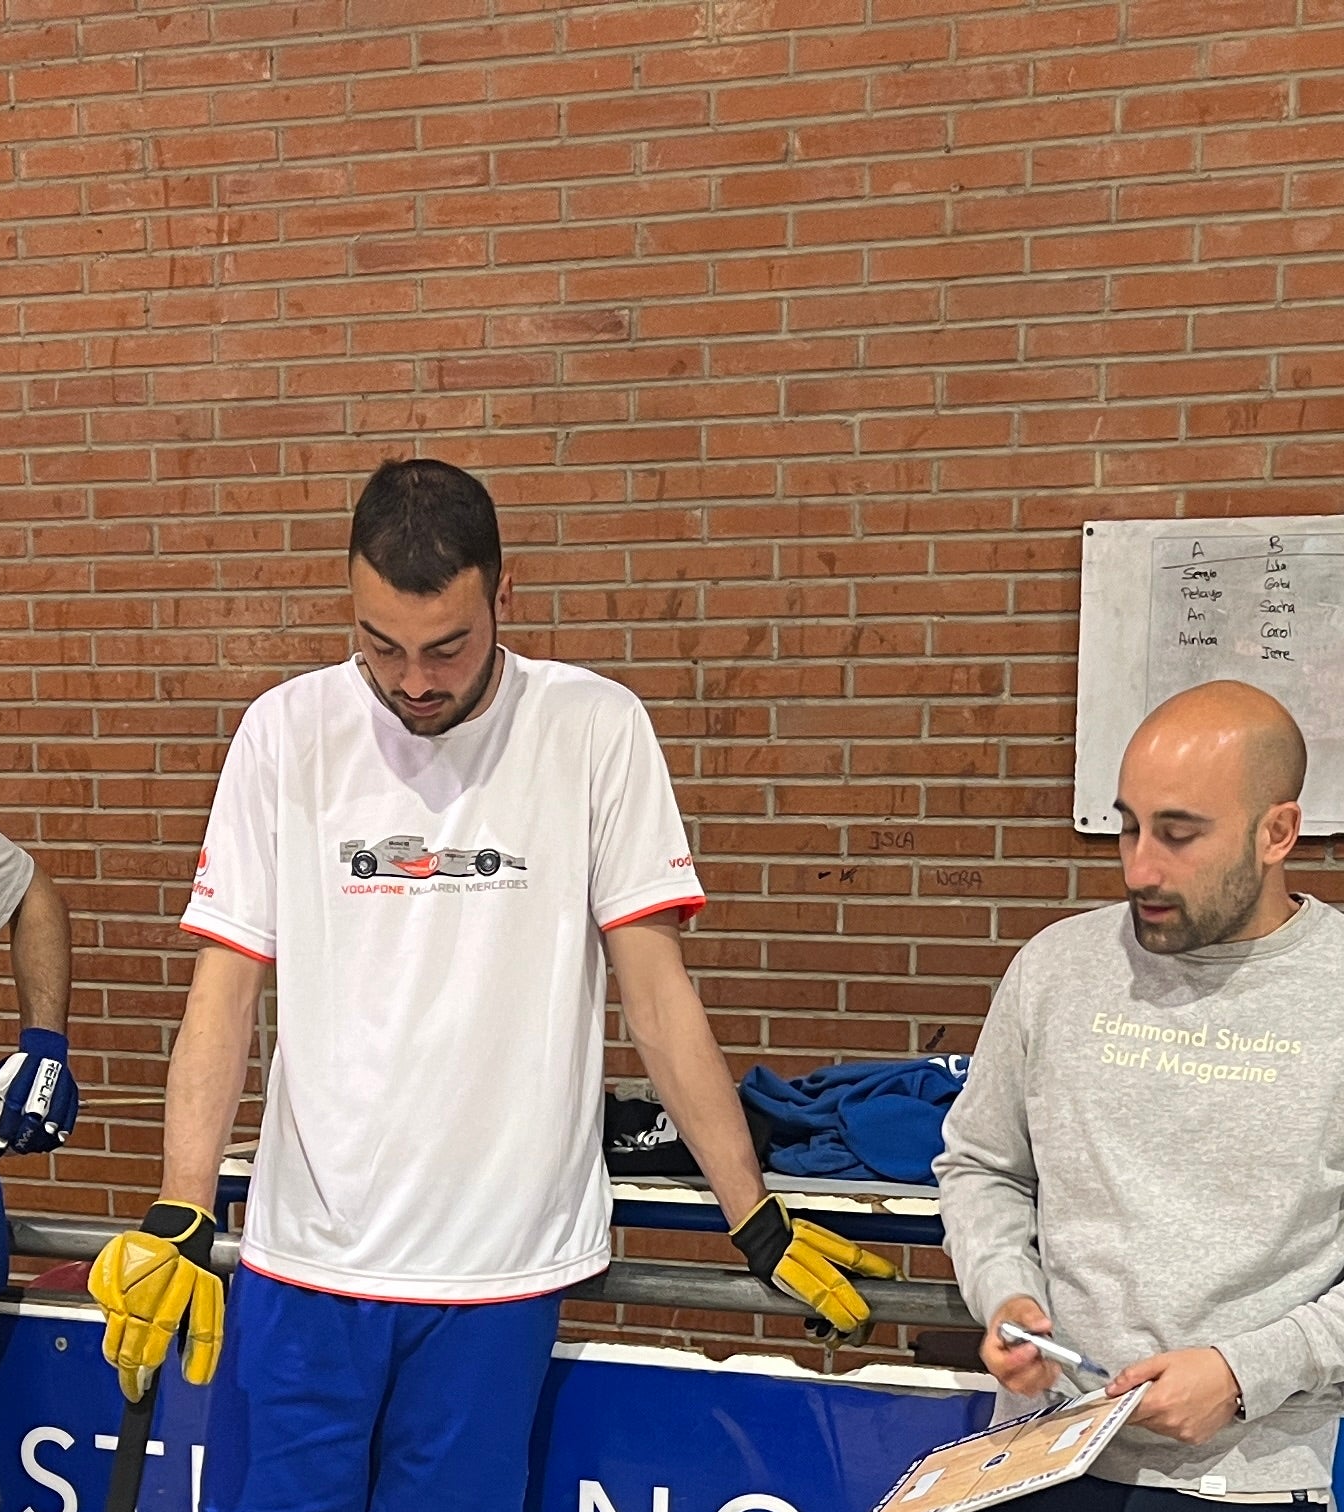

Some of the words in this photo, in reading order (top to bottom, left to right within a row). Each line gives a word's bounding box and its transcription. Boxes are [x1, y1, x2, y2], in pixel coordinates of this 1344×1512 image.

[1192, 541, 1205, 559] A
[1267, 535, 1284, 554] B
[1181, 586, 1222, 601] Pelayo
[1261, 621, 1292, 638] Carol
[341, 885, 405, 895] VODAFONE
[465, 880, 528, 892] MERCEDES
[1091, 1012, 1208, 1048] Edmmond
[1215, 1028, 1303, 1055] Studios
[1100, 1043, 1153, 1069] Surf
[1155, 1051, 1278, 1084] Magazine
